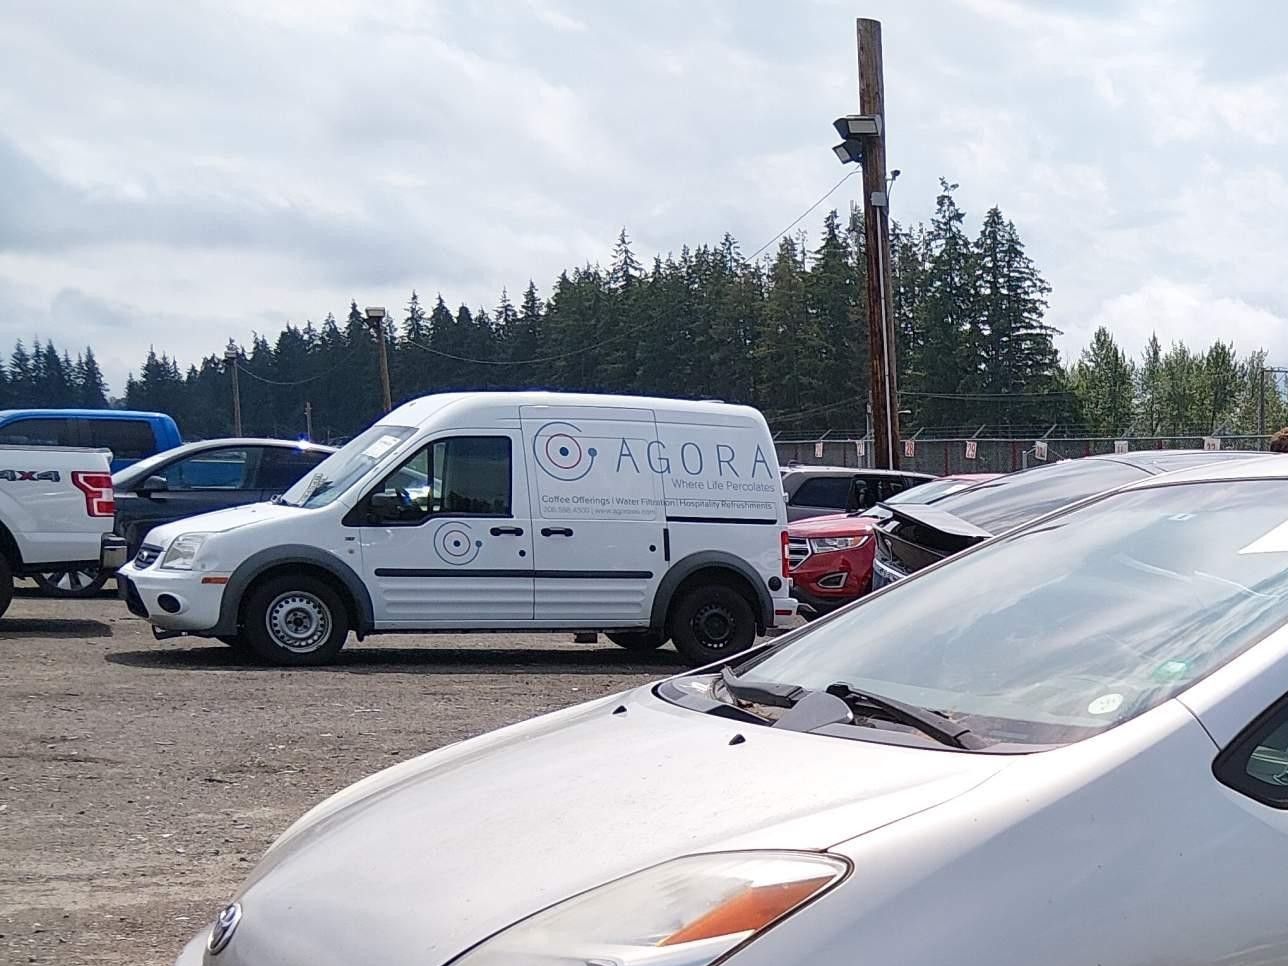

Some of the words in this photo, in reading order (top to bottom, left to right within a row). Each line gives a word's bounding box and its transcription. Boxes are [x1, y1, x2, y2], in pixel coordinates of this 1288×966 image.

[615, 437, 774, 479] AGORA
[671, 479, 704, 490] Where
[706, 480, 724, 491] Life
[726, 481, 776, 493] Percolates
[541, 495, 570, 504] Coffee
[571, 495, 610, 506] Offerings
[615, 497, 640, 506] Water
[680, 499, 720, 509] Hospitality
[720, 500, 773, 510] Refreshments
